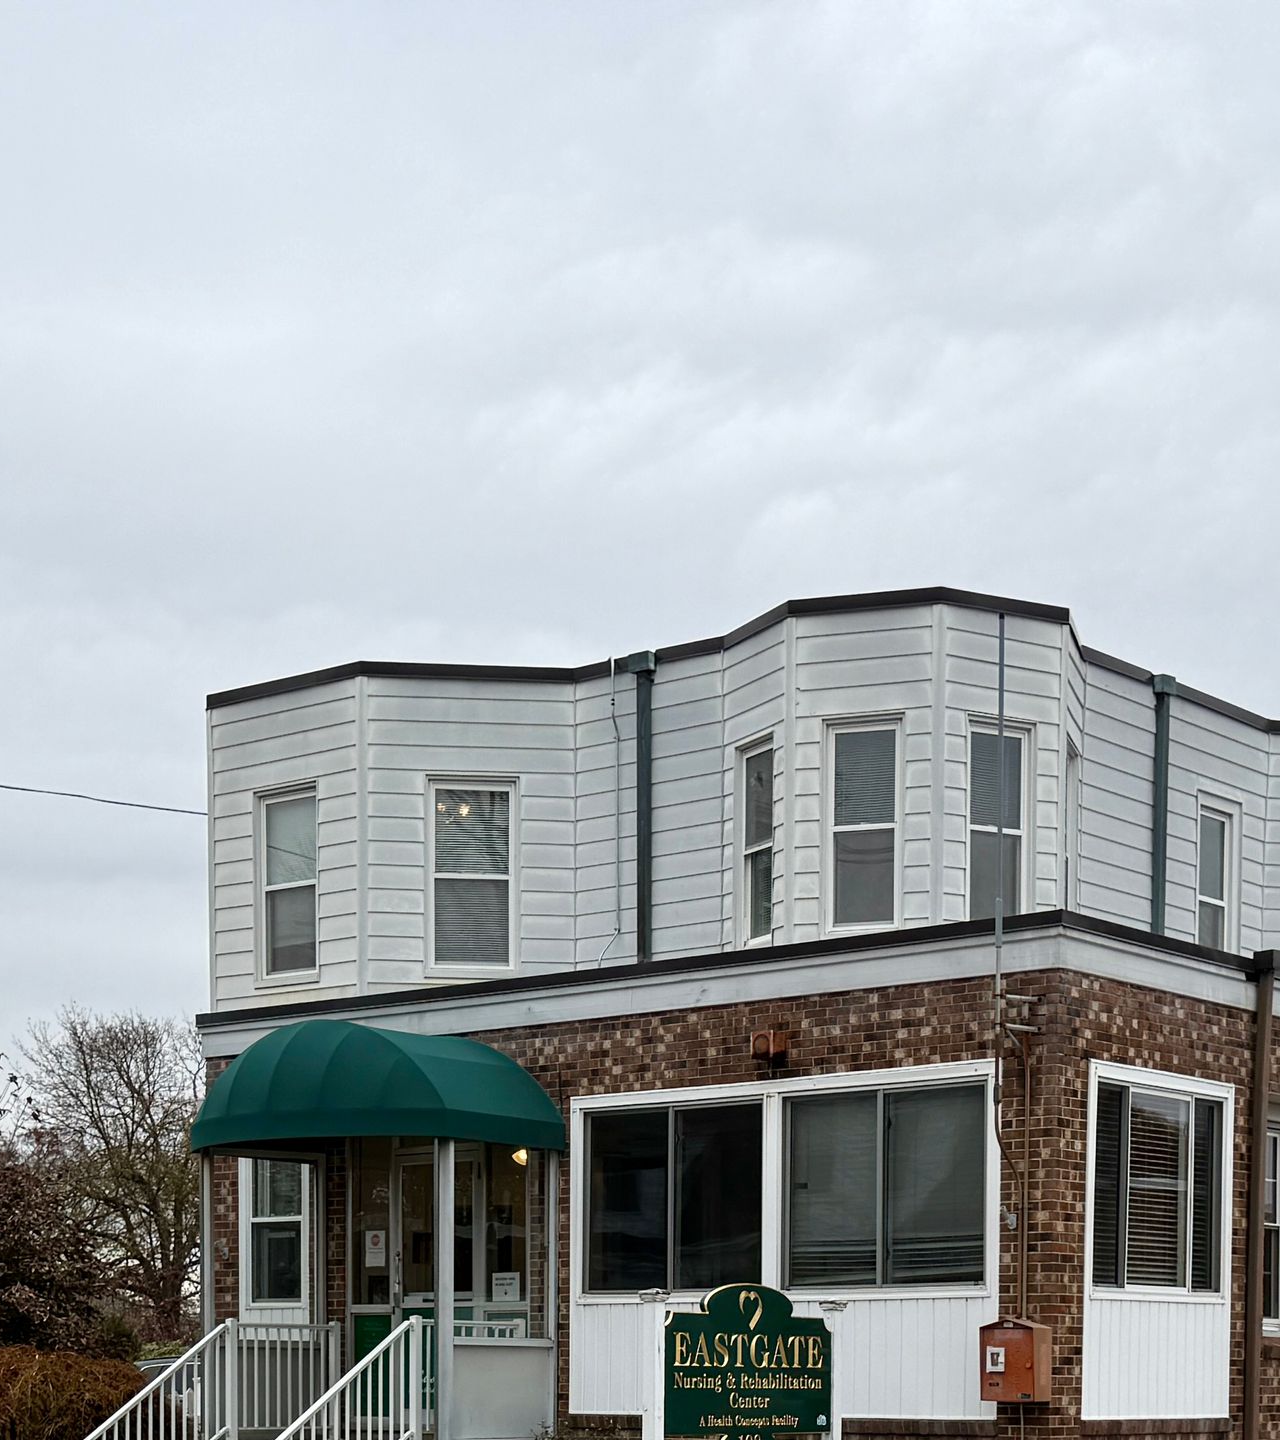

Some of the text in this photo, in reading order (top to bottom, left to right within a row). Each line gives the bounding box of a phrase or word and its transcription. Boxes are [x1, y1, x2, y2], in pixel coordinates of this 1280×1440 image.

[673, 1331, 823, 1368] EASTGATE
[673, 1372, 822, 1393] Nursing & Rehabilitation
[729, 1392, 770, 1409] Center
[699, 1414, 799, 1428] A Health Concepts Facility
